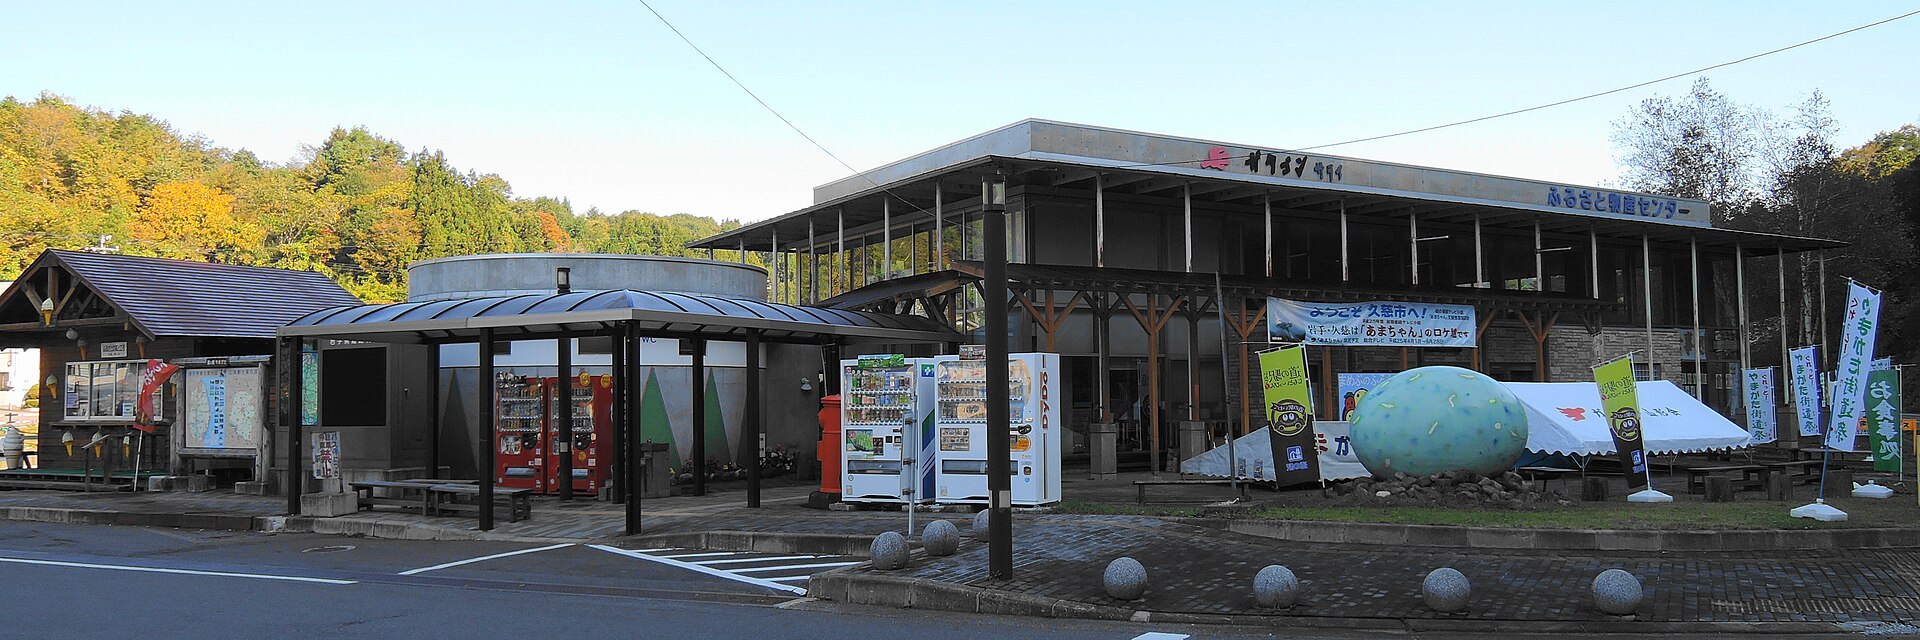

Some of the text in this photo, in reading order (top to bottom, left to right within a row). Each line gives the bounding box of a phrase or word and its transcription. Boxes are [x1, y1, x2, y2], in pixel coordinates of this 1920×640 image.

[1547, 187, 1690, 219] ふるさと物産センター
[1310, 306, 1362, 318] ようこそ
[1748, 372, 1766, 440] やまがた街道祭
[1794, 354, 1815, 433] やまがた街道祭
[320, 449, 332, 479] 禁止
